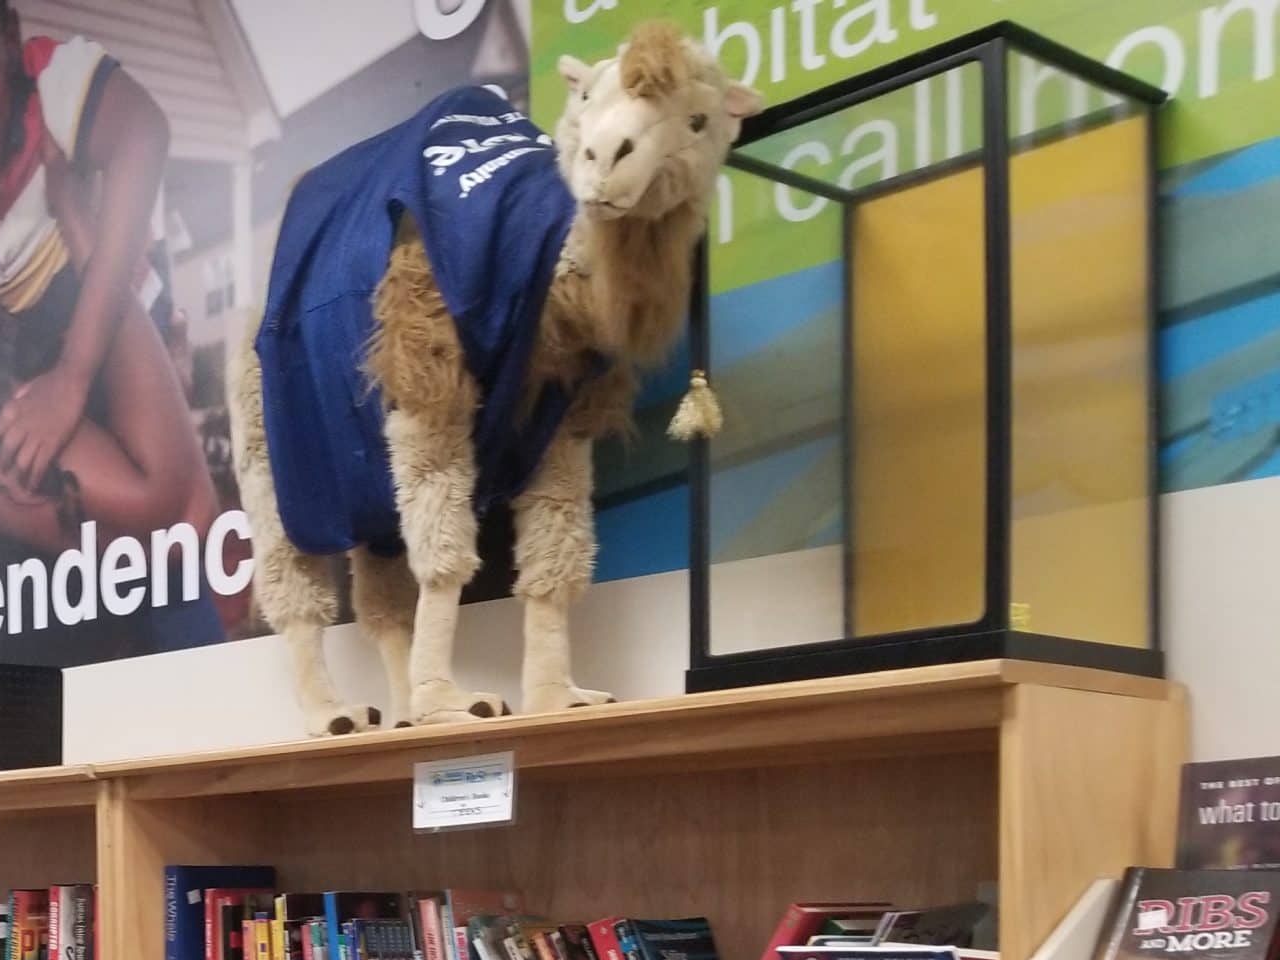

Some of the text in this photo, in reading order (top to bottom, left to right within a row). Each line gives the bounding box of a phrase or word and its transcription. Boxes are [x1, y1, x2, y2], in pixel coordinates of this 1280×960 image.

[1198, 799, 1255, 825] what
[1133, 892, 1271, 936] RIBS
[1166, 930, 1253, 953] MORE
